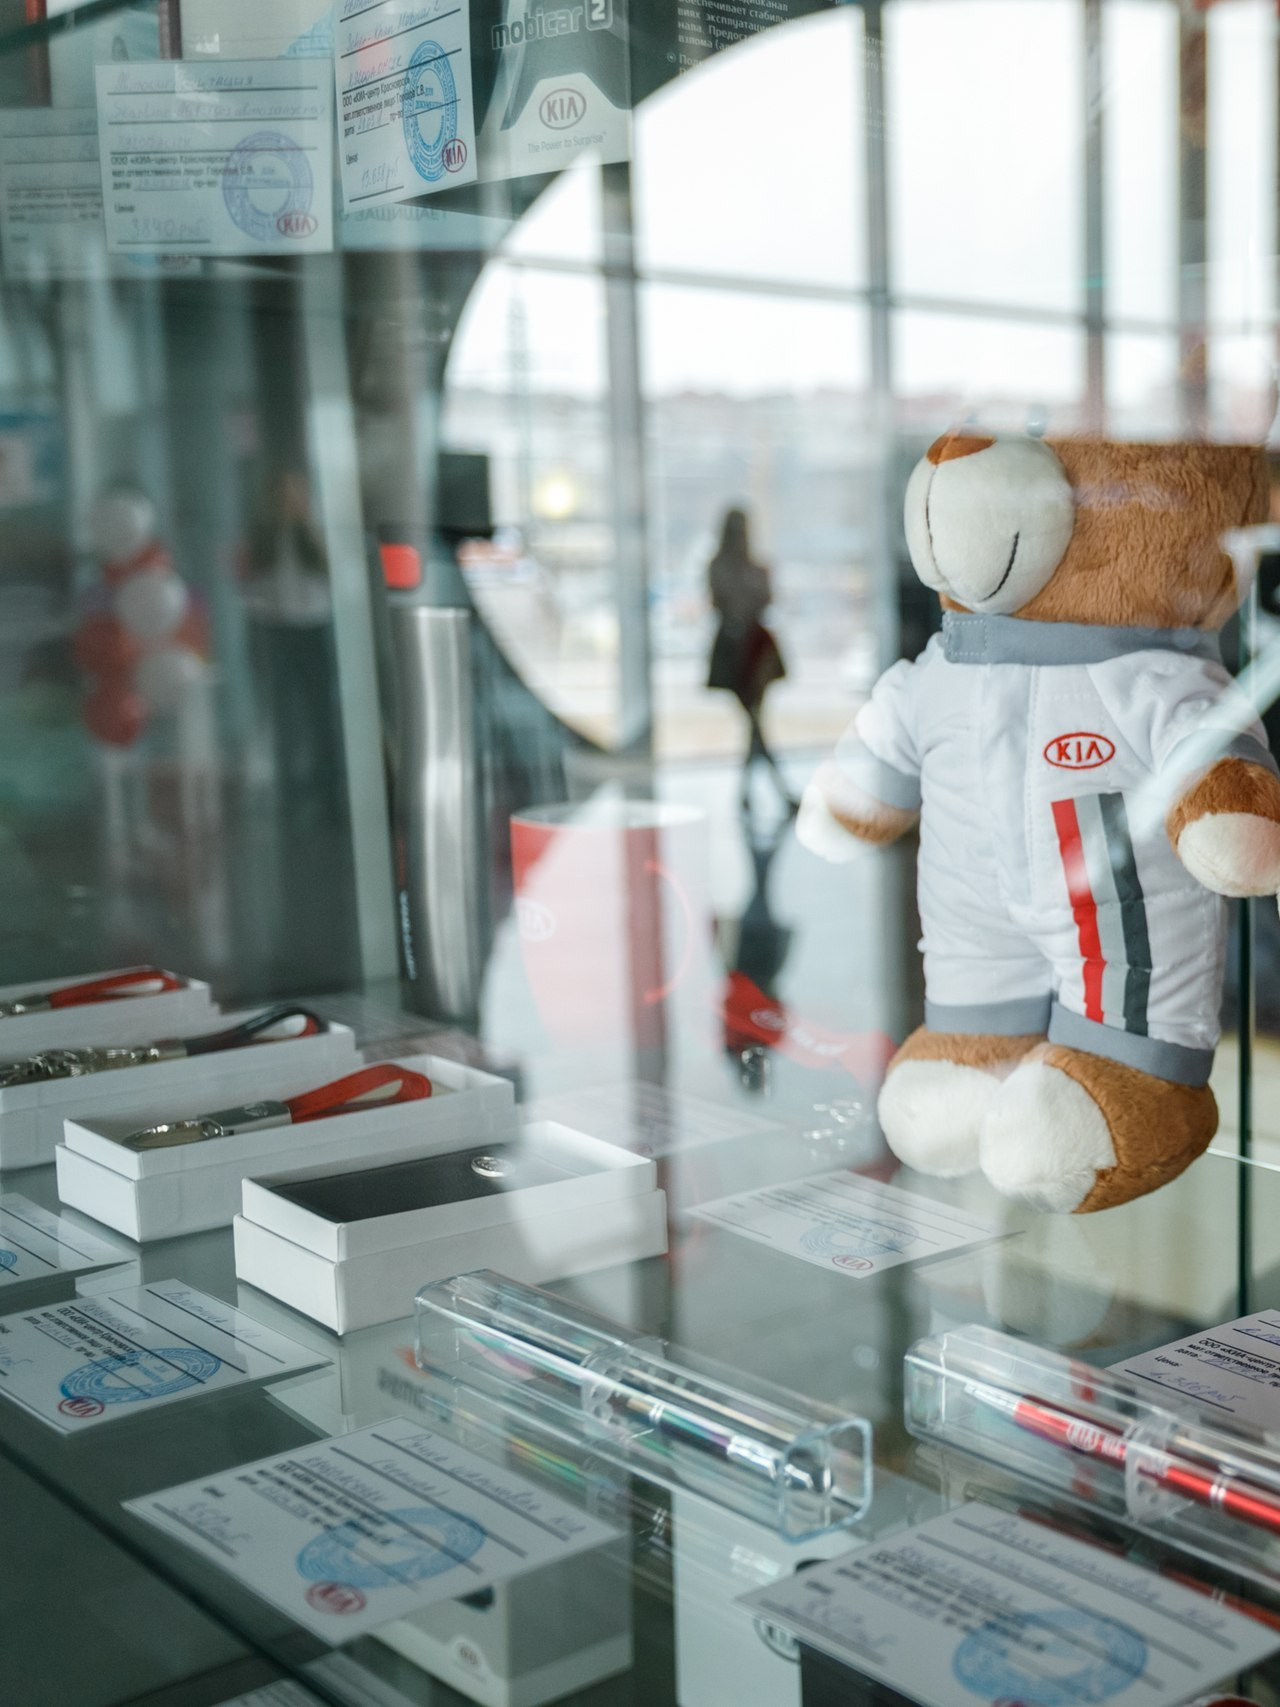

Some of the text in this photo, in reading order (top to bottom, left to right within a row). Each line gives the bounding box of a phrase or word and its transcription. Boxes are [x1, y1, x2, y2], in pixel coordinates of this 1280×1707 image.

[491, 5, 583, 50] mobicar
[546, 96, 579, 122] KIA
[528, 143, 540, 153] The
[541, 140, 563, 151] Power
[1055, 740, 1104, 763] KIA
[1198, 1339, 1221, 1349] ООО
